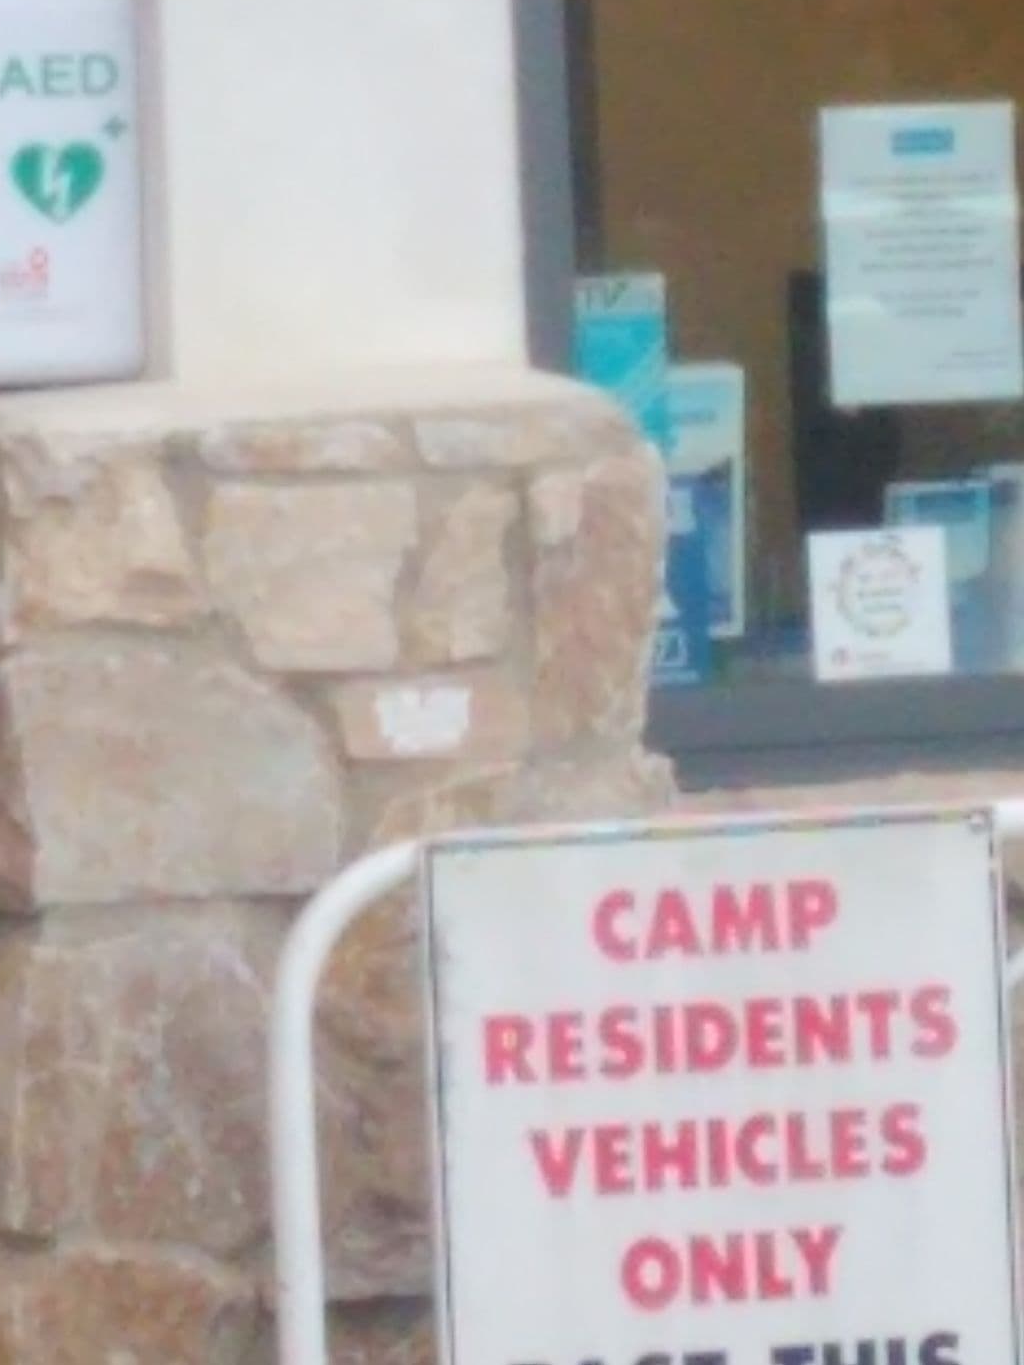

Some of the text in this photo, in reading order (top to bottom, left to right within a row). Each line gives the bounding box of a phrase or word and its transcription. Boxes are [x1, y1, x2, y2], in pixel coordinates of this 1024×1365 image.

[591, 878, 839, 962] CAMP
[483, 985, 958, 1087] RESIDENTS
[529, 1103, 927, 1198] VEHICLES
[619, 1225, 842, 1313] ONLY
